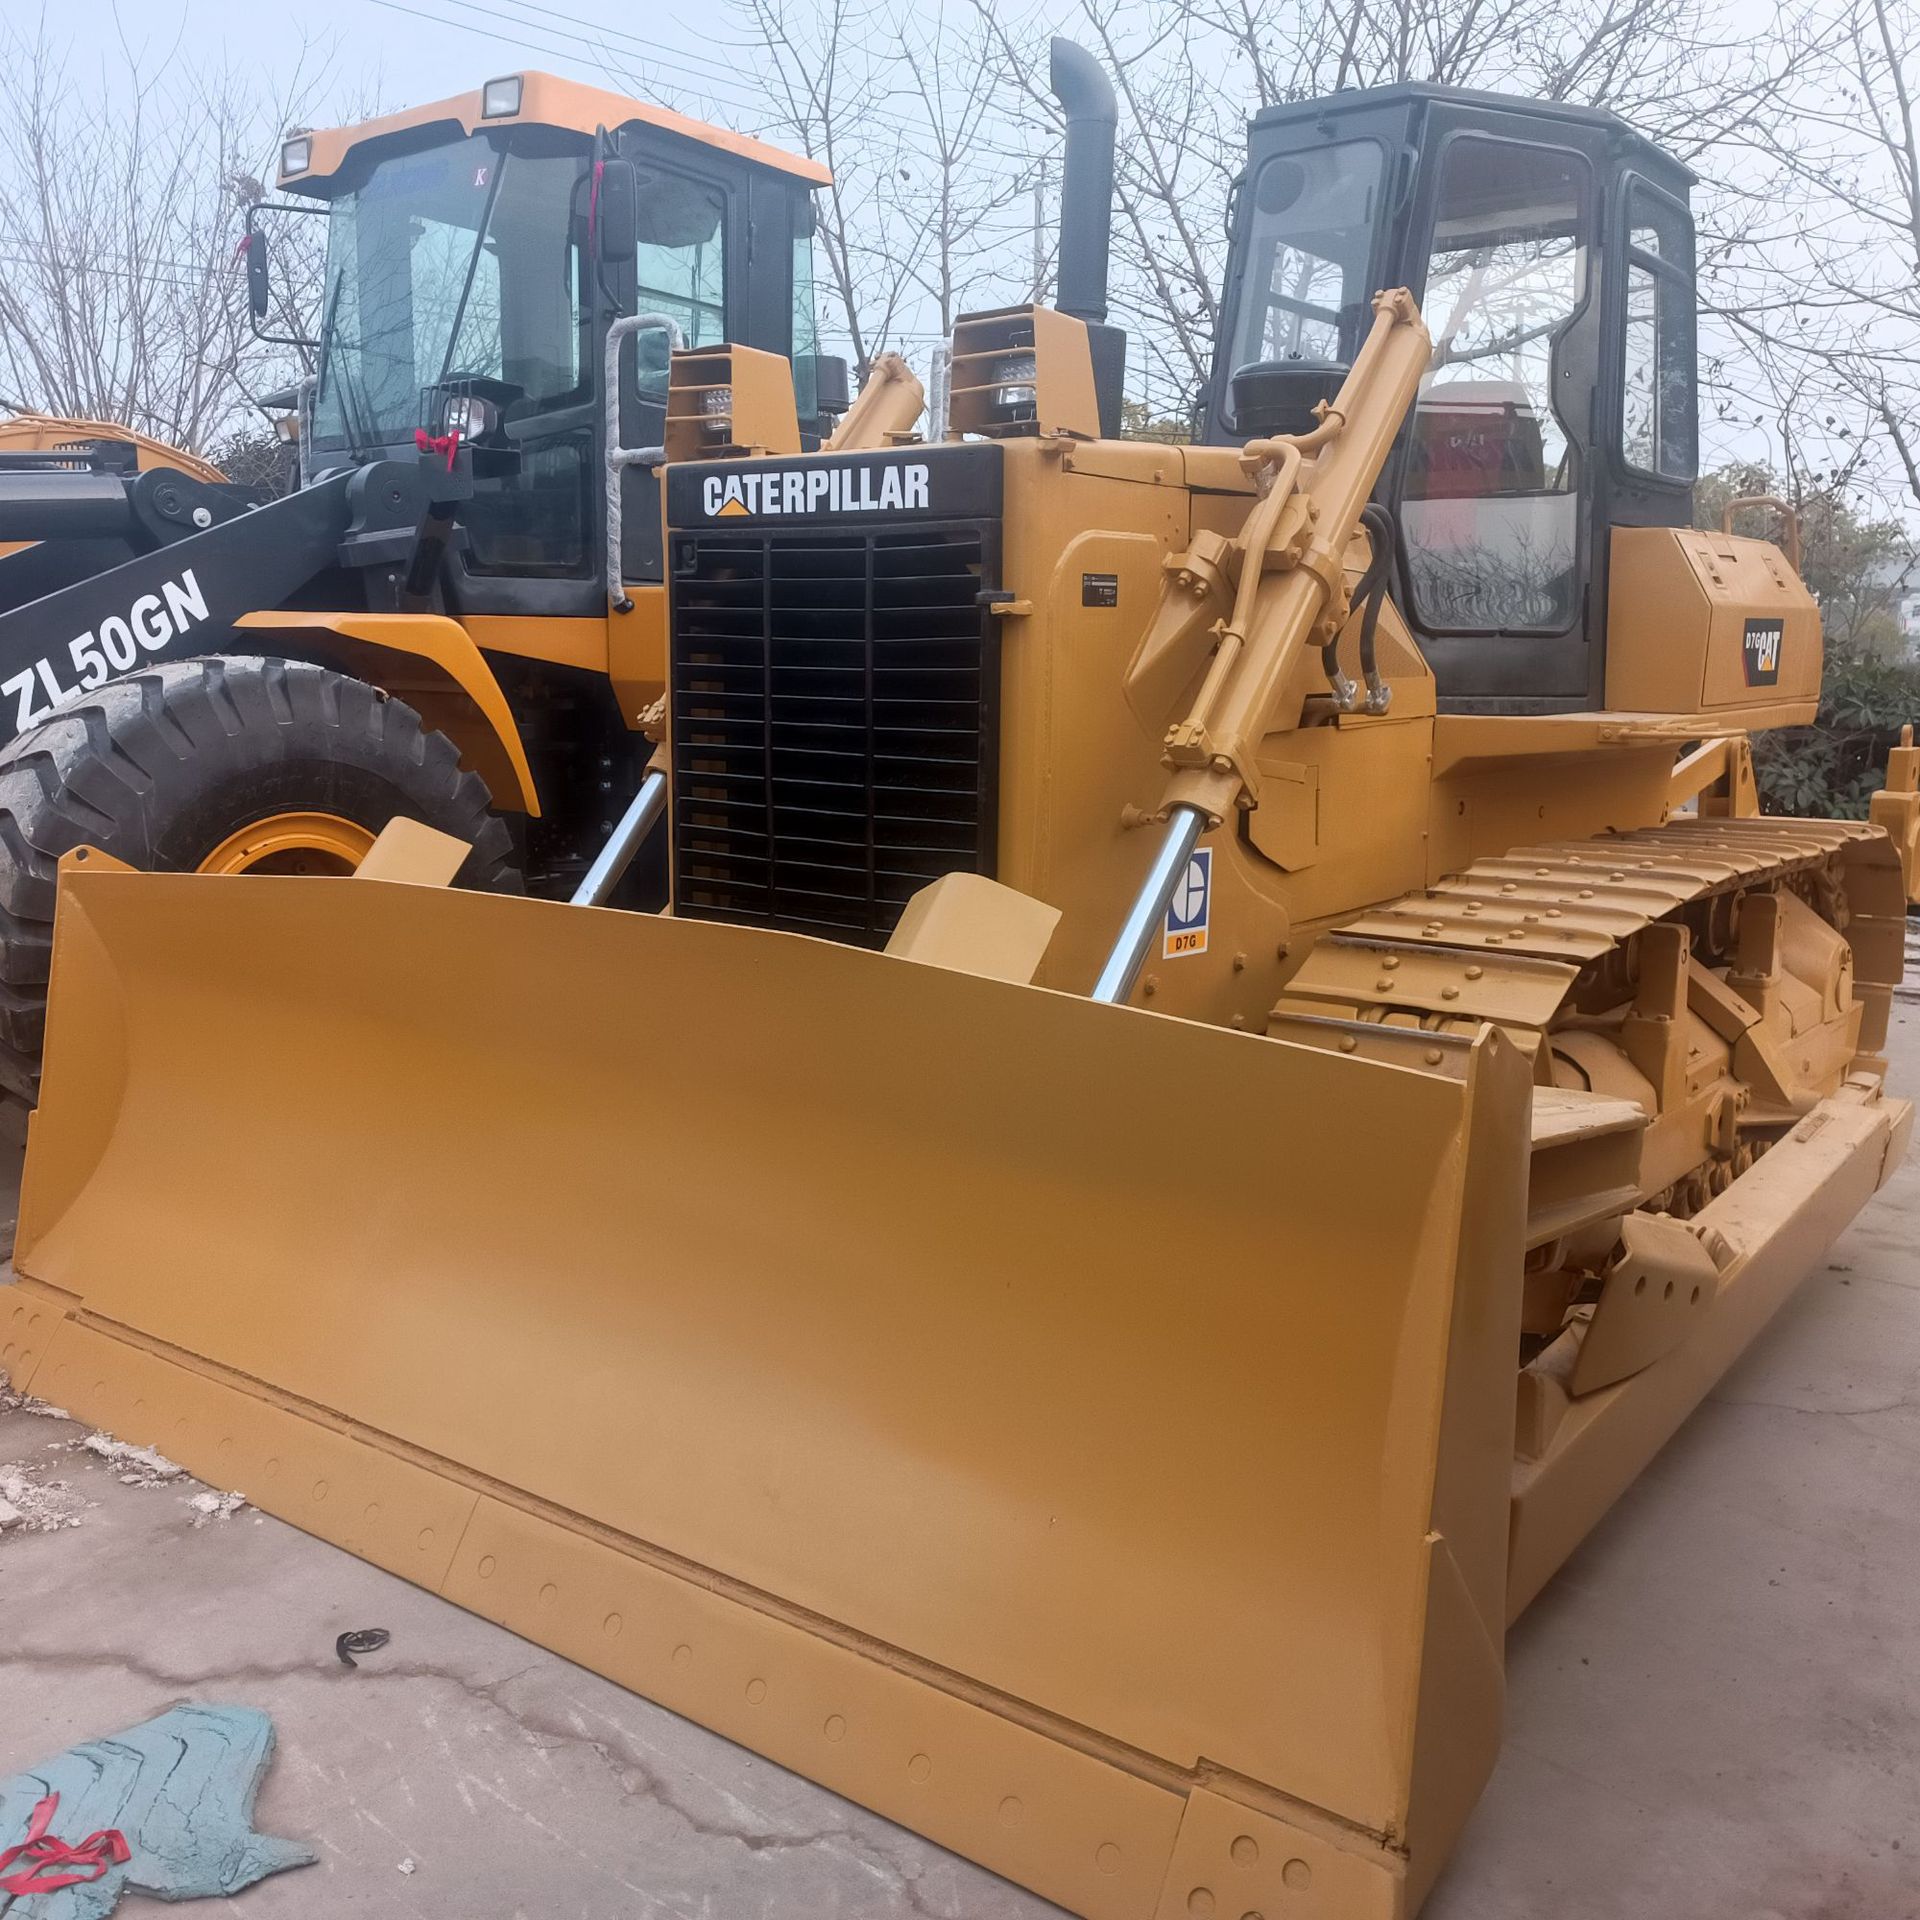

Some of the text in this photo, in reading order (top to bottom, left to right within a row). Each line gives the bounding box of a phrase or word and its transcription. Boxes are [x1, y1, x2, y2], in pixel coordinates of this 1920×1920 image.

[474, 168, 487, 186] K
[703, 464, 929, 517] CATERPILLAR
[0, 568, 210, 735] ZL50GN
[1745, 631, 1781, 672] D7G CAT
[1175, 934, 1197, 951] D7G
